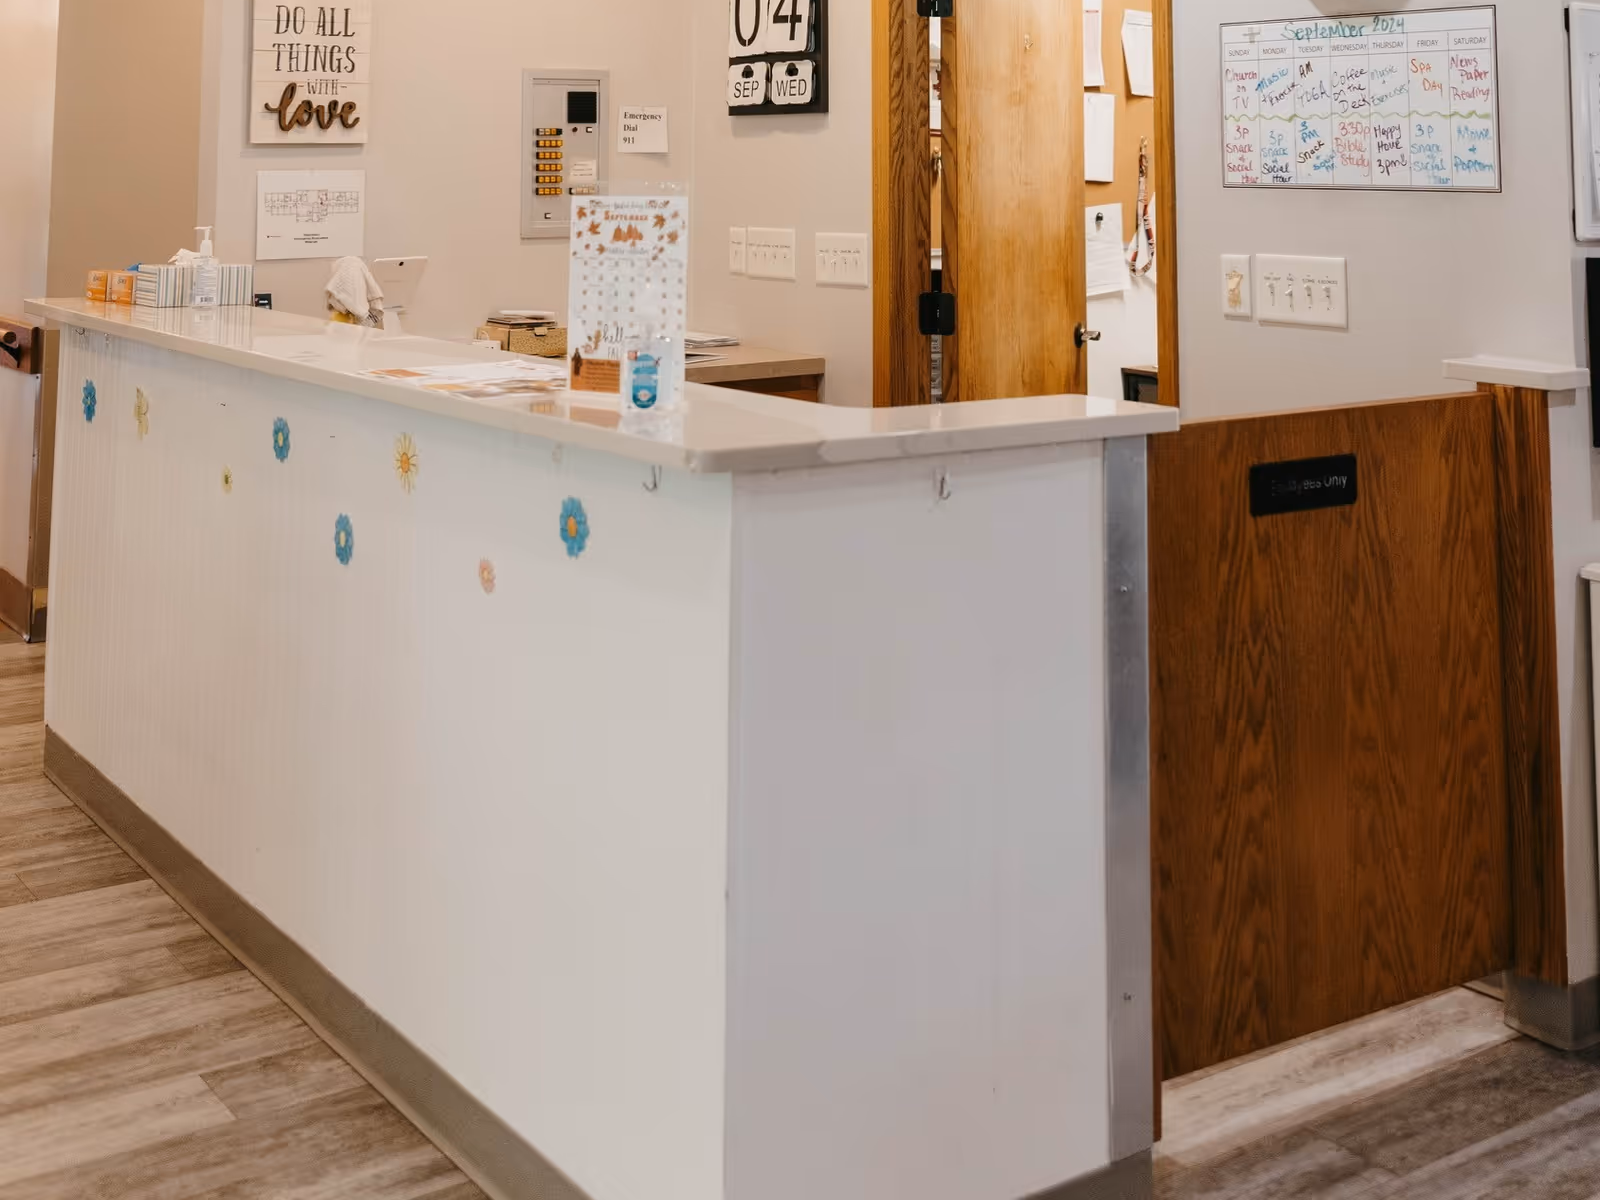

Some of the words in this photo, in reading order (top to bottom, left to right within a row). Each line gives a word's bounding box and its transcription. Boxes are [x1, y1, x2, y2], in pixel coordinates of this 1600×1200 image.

[275, 5, 305, 34] DO
[316, 6, 355, 37] ALL
[1280, 20, 1365, 41] September
[1373, 15, 1405, 33] 2024
[1331, 43, 1368, 52] WEDNESDAY
[273, 43, 355, 73] THINGS
[1450, 54, 1478, 69] News
[1226, 69, 1257, 80] Church
[1299, 61, 1313, 79] AM
[1332, 65, 1367, 87] Coffee
[1255, 68, 1288, 92] Music
[734, 81, 759, 98] SEP
[776, 79, 806, 96] WED
[1333, 89, 1345, 101] on
[1450, 87, 1489, 102] Reading
[264, 82, 360, 131] love
[1233, 96, 1249, 108] TV
[1339, 93, 1370, 113] Deck
[624, 112, 662, 121] Emergency
[1300, 121, 1307, 131] 3
[1374, 124, 1401, 139] Happy
[1226, 143, 1253, 153] Snack
[1297, 141, 1324, 164] Snack
[1335, 137, 1367, 153] Bible
[1262, 163, 1289, 174] Social
[1340, 154, 1369, 177] Study
